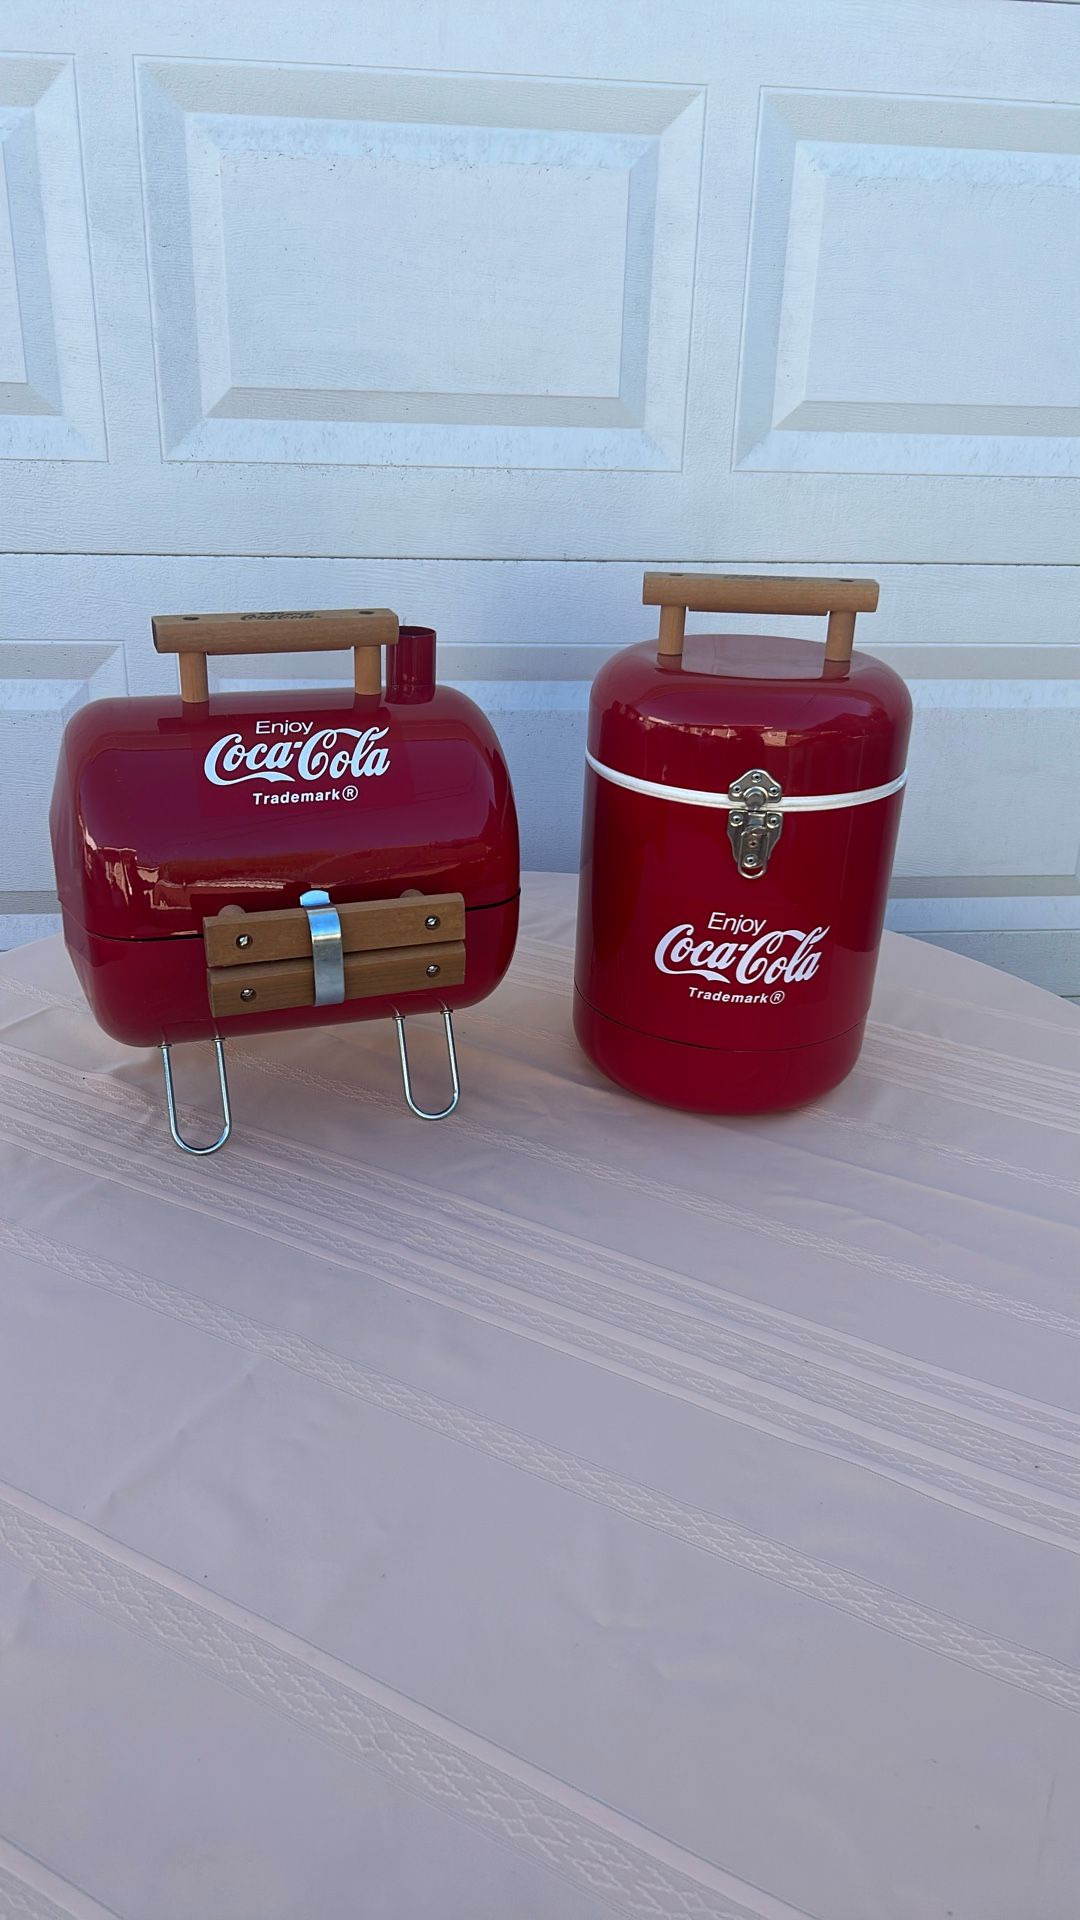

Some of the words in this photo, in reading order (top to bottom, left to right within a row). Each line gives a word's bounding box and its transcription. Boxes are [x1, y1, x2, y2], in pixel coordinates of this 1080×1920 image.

[255, 720, 313, 735] Enjoy
[204, 727, 391, 786] Coca-Cola
[707, 911, 767, 936] Enjoy
[655, 924, 831, 985] Coca-Cola
